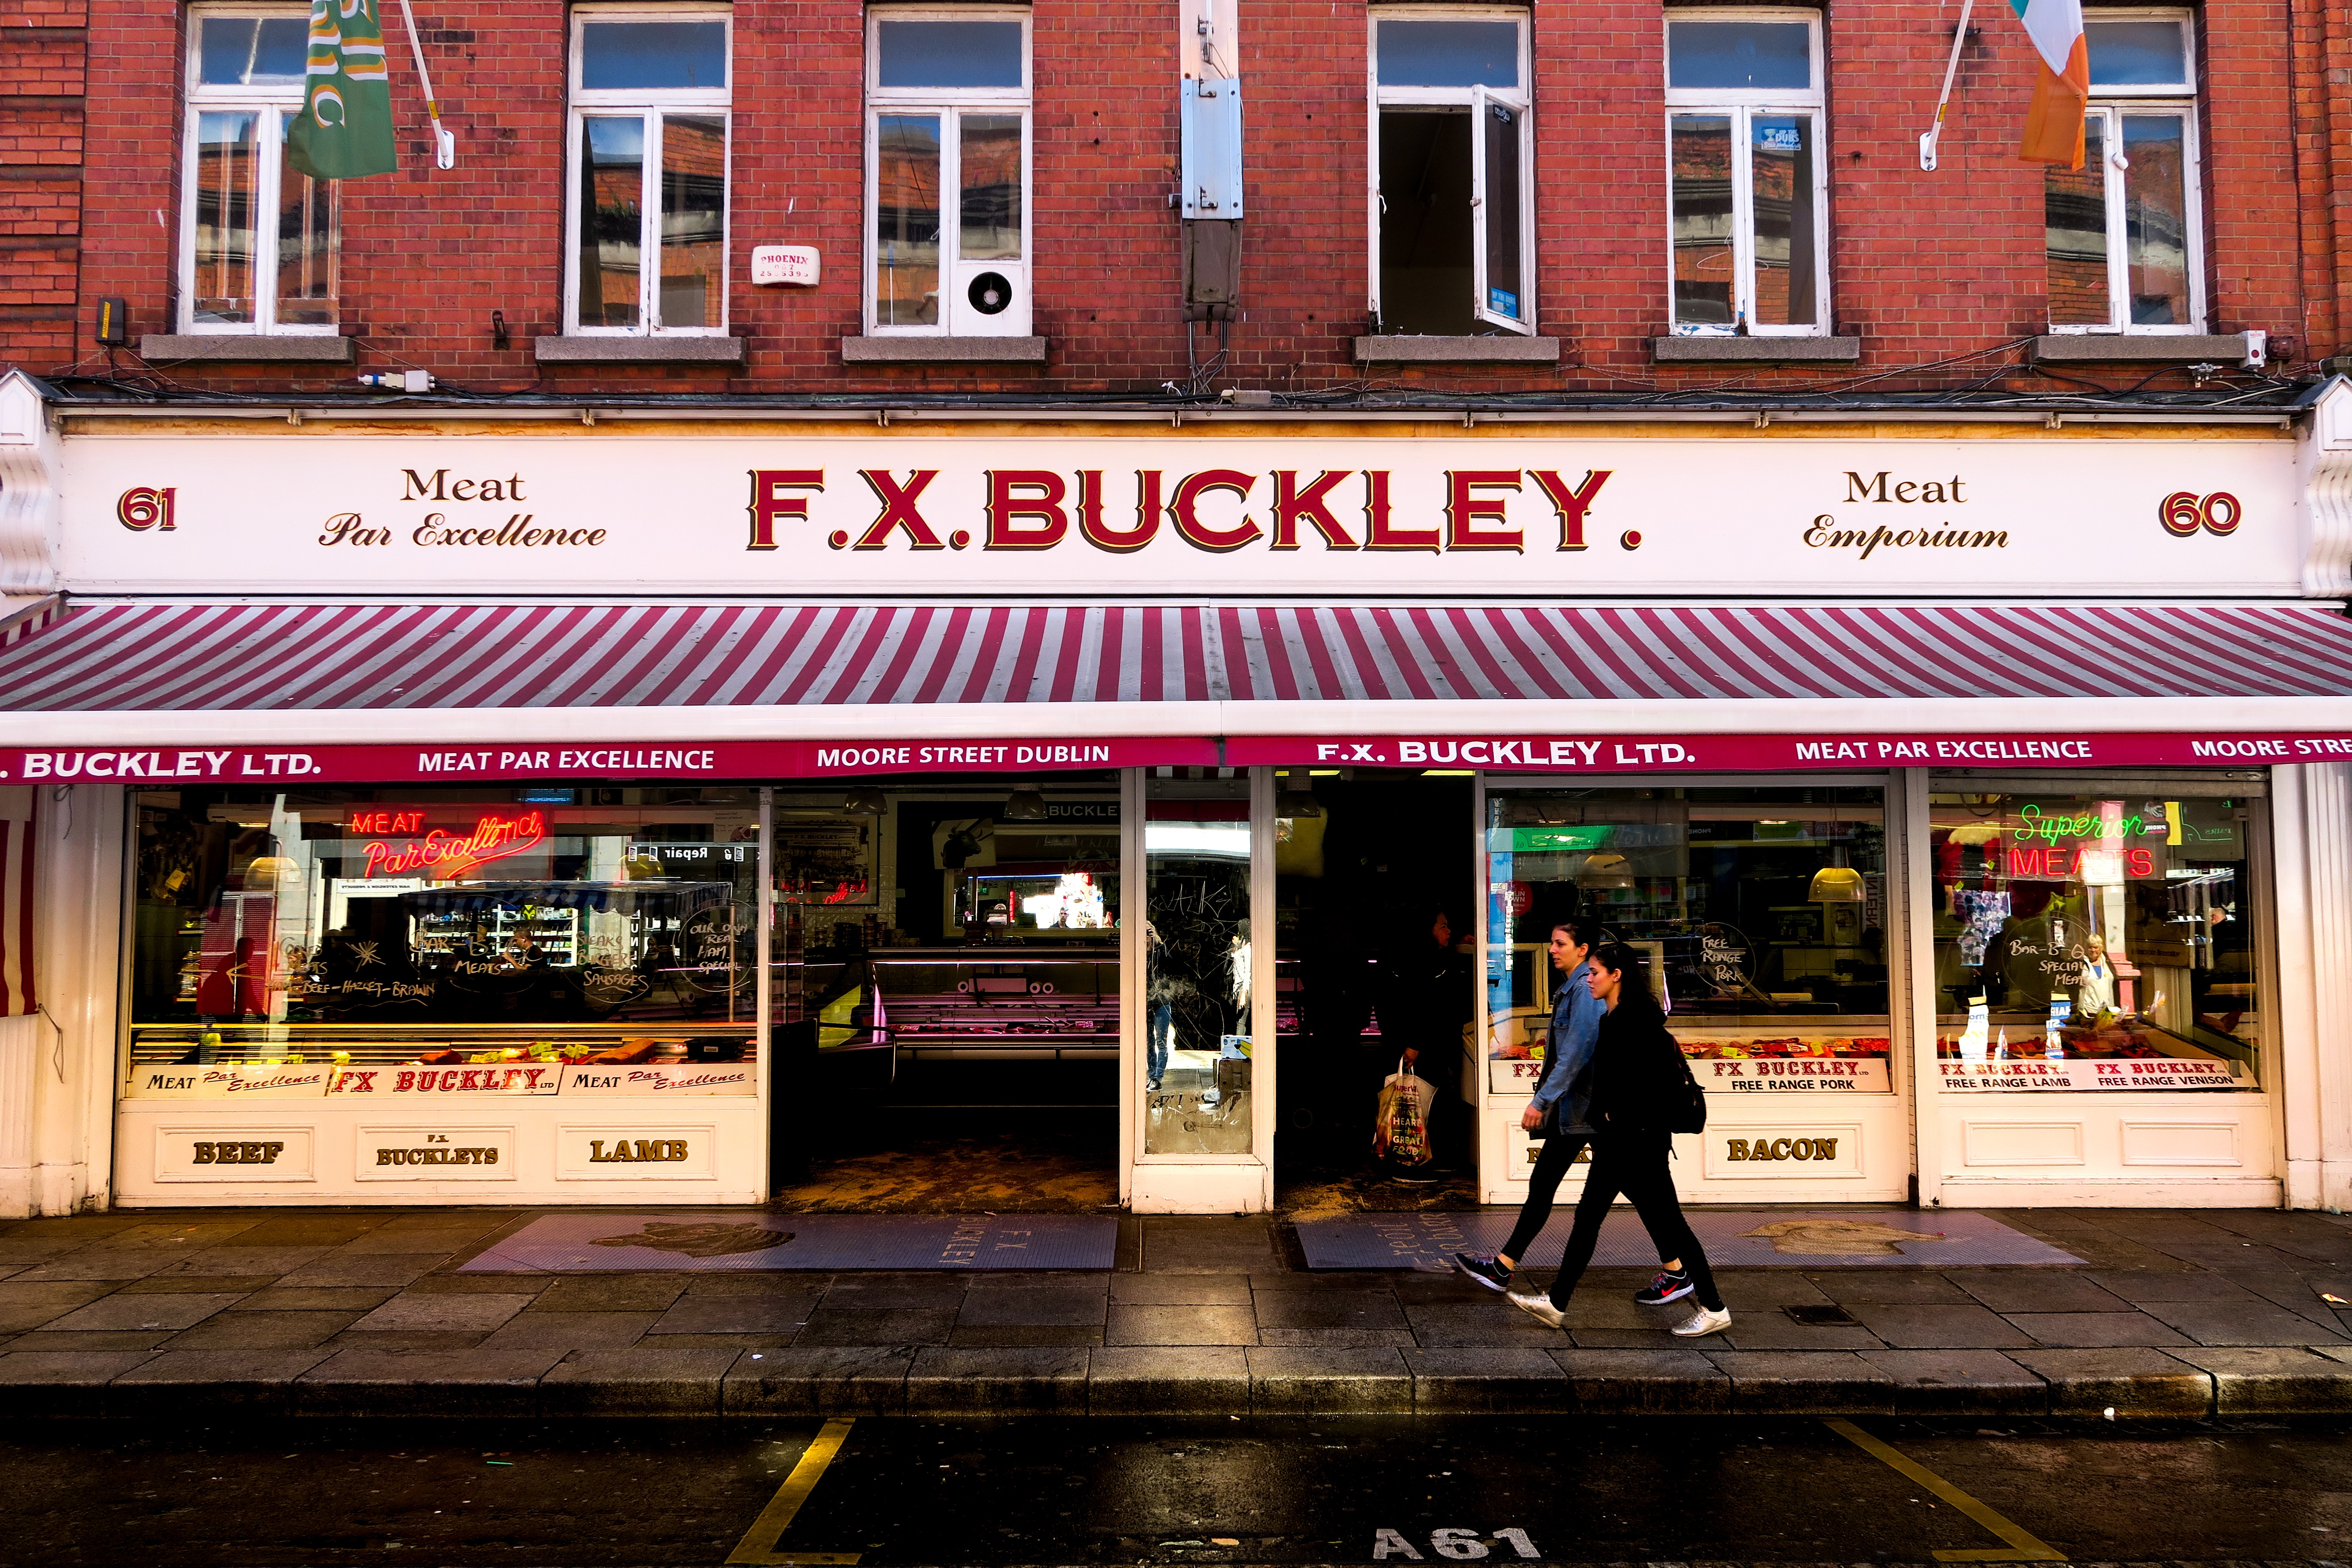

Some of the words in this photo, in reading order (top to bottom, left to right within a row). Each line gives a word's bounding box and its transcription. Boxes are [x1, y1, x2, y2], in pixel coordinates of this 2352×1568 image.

[760, 255, 808, 265] PHOENIX
[399, 468, 527, 502] Meat
[1842, 470, 1969, 504] Meat
[116, 486, 179, 532] 61
[2157, 490, 2242, 538] 60
[317, 512, 393, 548] Par
[412, 512, 607, 548] Excellence
[1802, 514, 2009, 561] Emporium
[817, 747, 911, 767] MOORE
[919, 746, 1008, 764] STREET
[1016, 745, 1110, 763] DUBLIN
[1317, 742, 1385, 763] F.X.
[1398, 741, 1602, 766] BUCKLEY
[1614, 743, 1696, 765] LTD.
[1795, 741, 1869, 760] MEAT
[1877, 741, 1931, 758] PAR
[1935, 741, 2093, 759] EXCELLENCE
[2191, 739, 2290, 757] MOORE
[22, 751, 233, 779] BUCKLEY
[241, 753, 322, 775] LTD.
[418, 751, 493, 772] MEAT
[499, 751, 551, 770] PAR
[558, 750, 715, 770] EXCELLENCE
[351, 812, 424, 833] MEAT
[2014, 803, 2149, 847] Superior
[361, 841, 423, 878] Par
[2010, 847, 2154, 876] MEATS
[690, 924, 714, 934] OUR
[723, 923, 748, 934] OWN
[1702, 935, 1729, 948] FREE
[1700, 949, 1743, 963] RANGE
[454, 960, 502, 975] MEATS
[698, 961, 741, 974] SPECIAL
[1714, 964, 1743, 982] PORK
[583, 970, 649, 991] SAUSAGES
[1713, 1062, 1743, 1077] FX
[1756, 1061, 1859, 1076] BUCKLEY
[1939, 1064, 1965, 1075] FX
[1977, 1063, 2060, 1075] BUCKLEY
[2094, 1063, 2119, 1075] FX
[2130, 1063, 2217, 1075] BUCKLEY
[146, 1074, 196, 1090] MEAT
[202, 1071, 238, 1083] Par
[227, 1073, 321, 1091] Excellence
[333, 1071, 379, 1093] FX
[393, 1068, 546, 1093] BUCKLEY
[573, 1074, 621, 1088] MEAT
[627, 1071, 662, 1082] Par
[653, 1072, 746, 1090] Excellence
[1732, 1081, 1765, 1090] FREE
[1768, 1080, 1816, 1090] RANGE
[1819, 1079, 1856, 1090] PORK
[1945, 1079, 1976, 1088] FREE
[1981, 1078, 2029, 1088] RANGE
[2032, 1077, 2071, 1087] LAMB
[2098, 1077, 2128, 1087] FREE
[2133, 1076, 2176, 1086] RANGE
[2180, 1075, 2234, 1085] VENISON
[193, 1141, 285, 1164] BEEF
[376, 1147, 499, 1166] BUCKLEYS
[589, 1139, 689, 1162] LAMB
[1392, 1145, 1419, 1156] FOOD
[1727, 1138, 1838, 1161] BACON
[1373, 1528, 1541, 1559] A61
